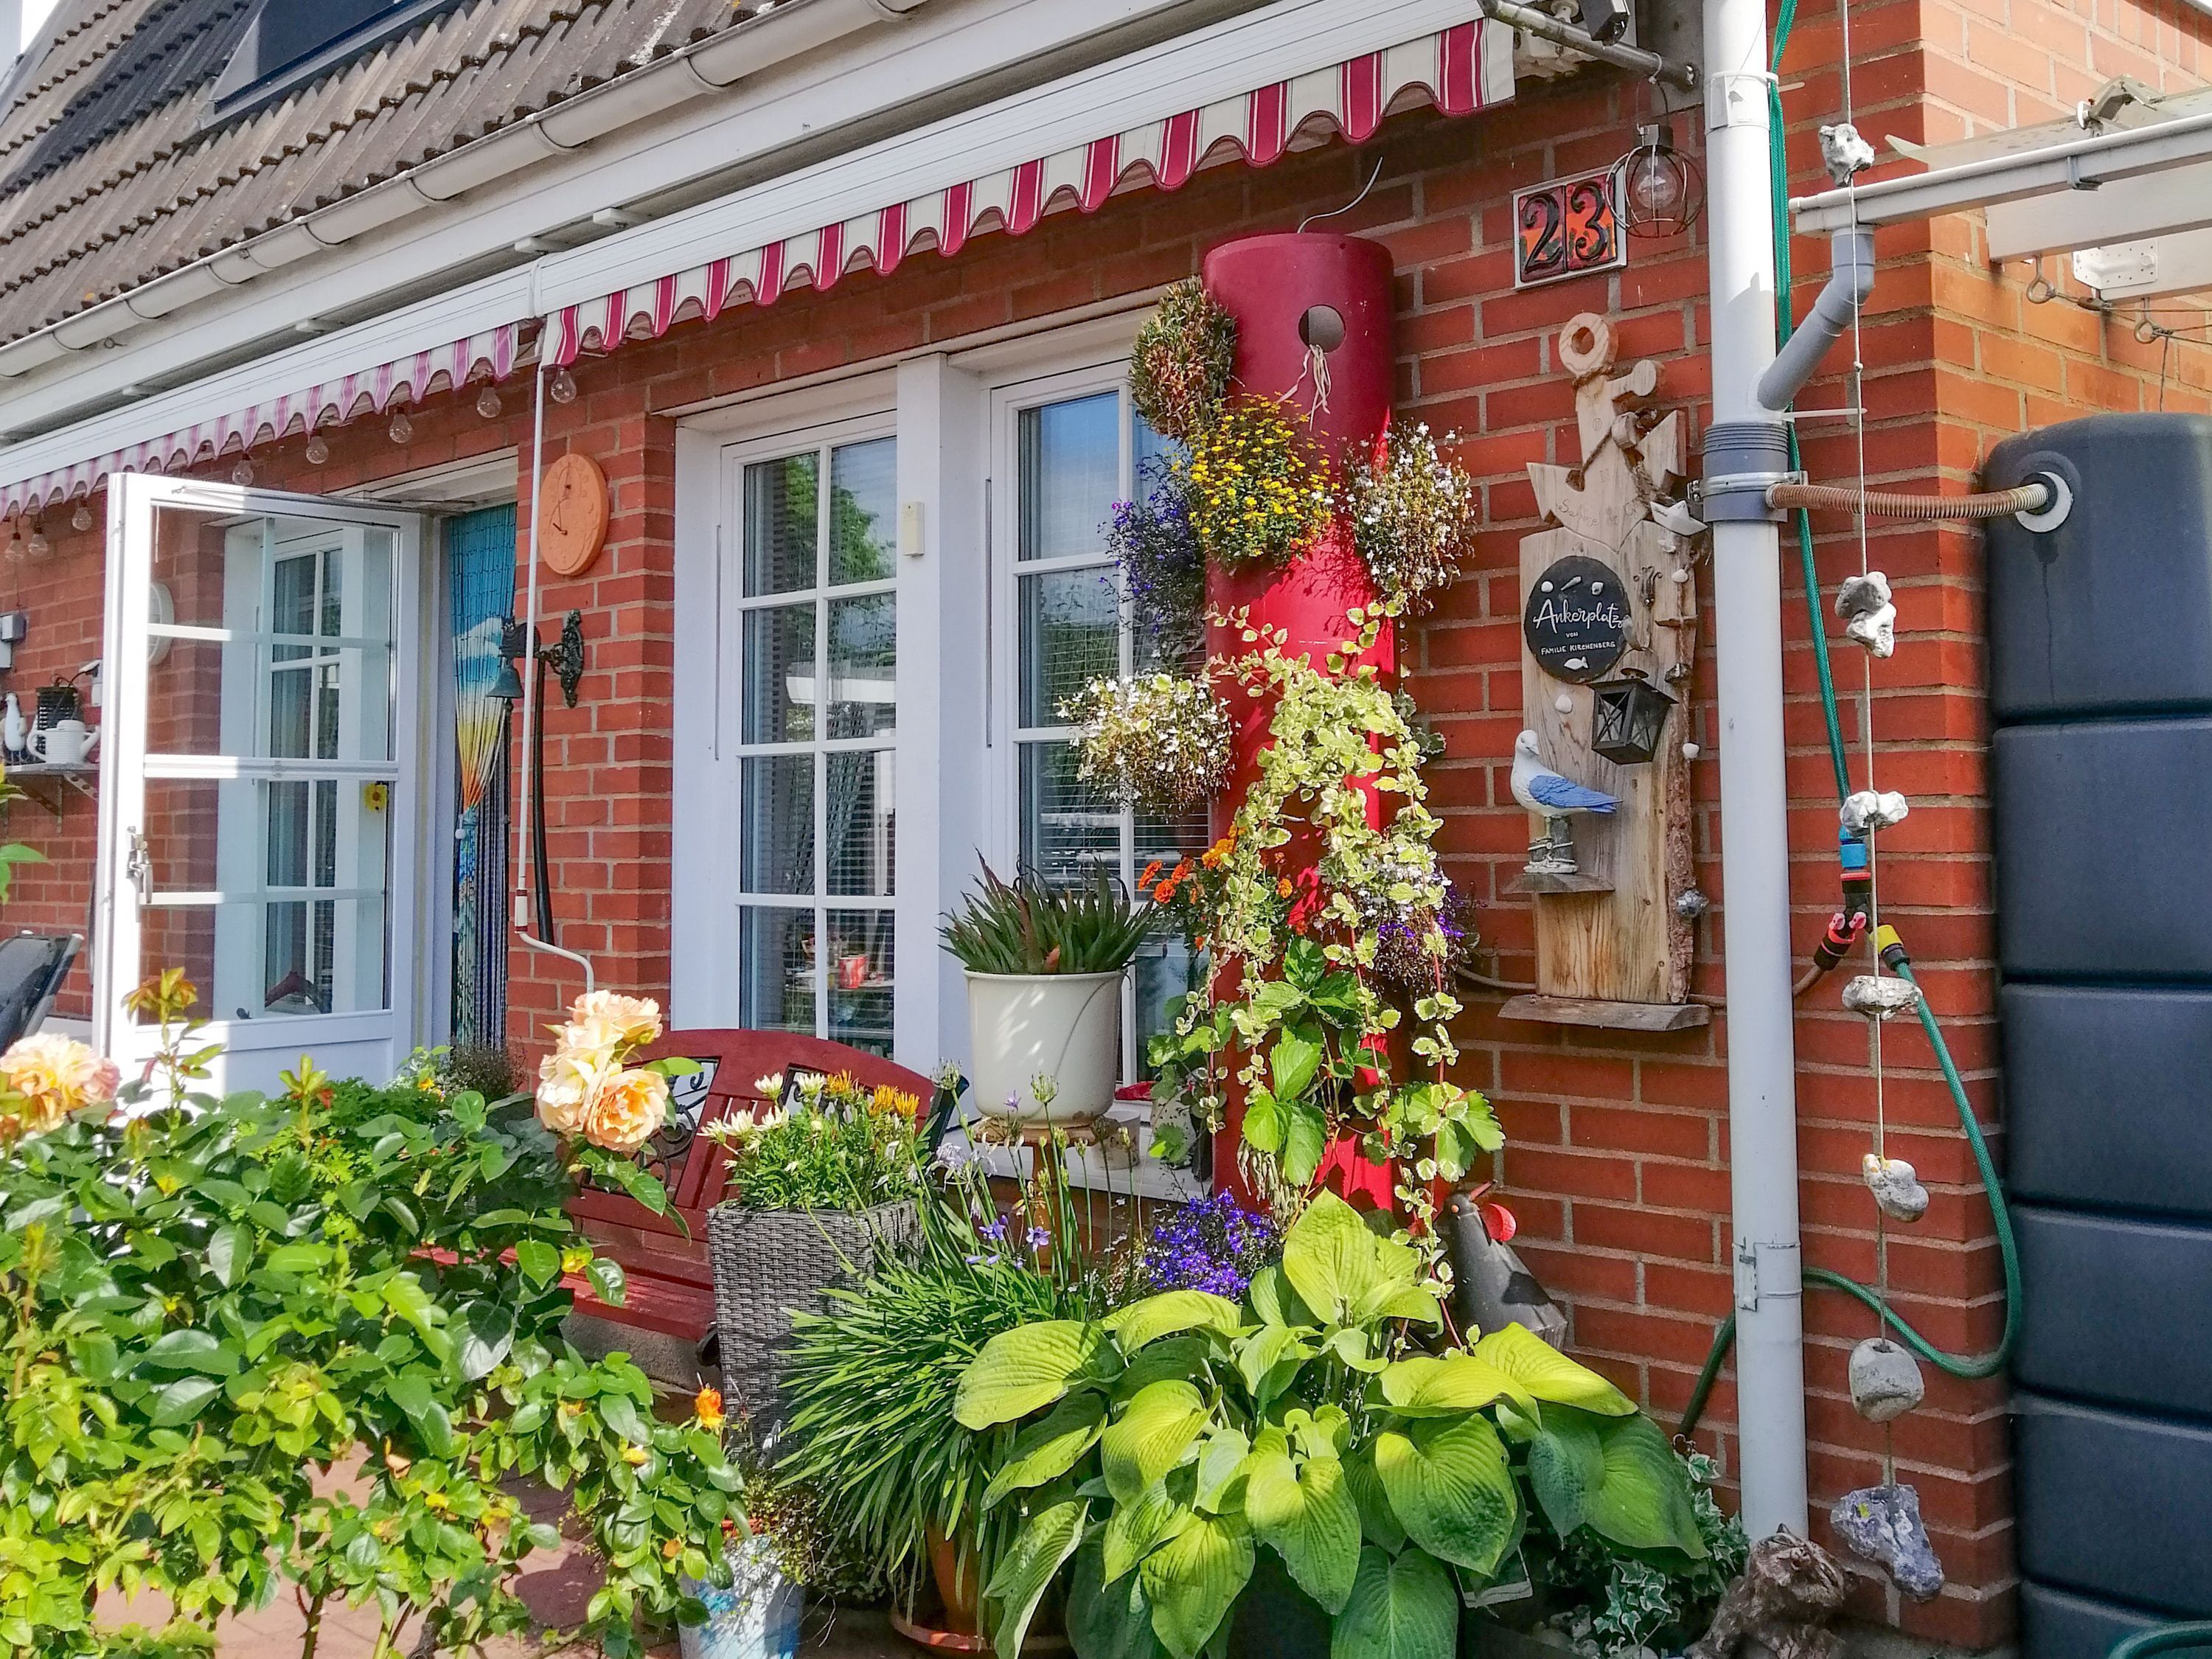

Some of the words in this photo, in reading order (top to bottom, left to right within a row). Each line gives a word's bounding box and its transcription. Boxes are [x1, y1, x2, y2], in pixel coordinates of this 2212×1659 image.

[1523, 181, 1607, 274] 23
[1533, 599, 1623, 633] Ankerplatz
[1540, 645, 1567, 655] FAMILIE
[1569, 641, 1616, 652] KIRCHENBERG
